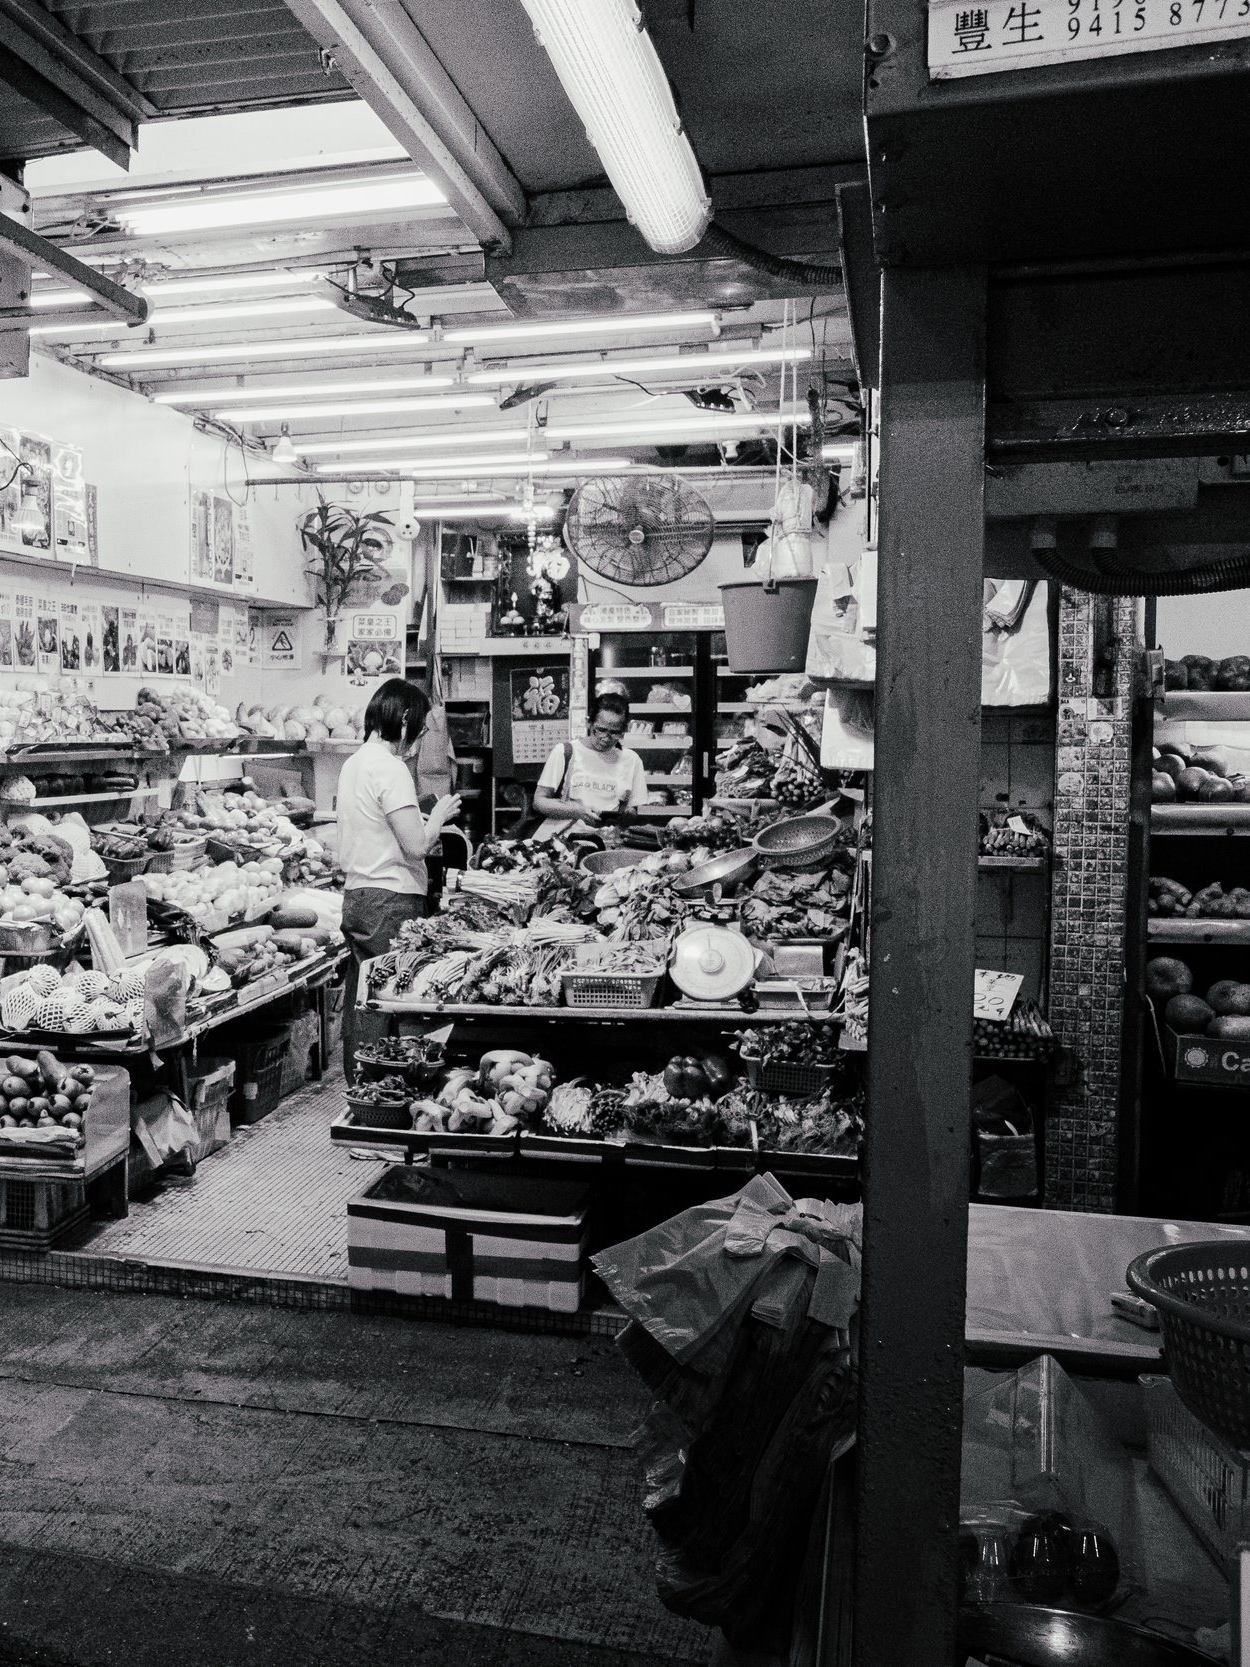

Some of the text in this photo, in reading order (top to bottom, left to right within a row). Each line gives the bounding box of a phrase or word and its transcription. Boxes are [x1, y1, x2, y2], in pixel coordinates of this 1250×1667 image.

[951, 2, 1044, 54] 豐生
[1068, 7, 1146, 41] 9415
[523, 675, 561, 716] 福
